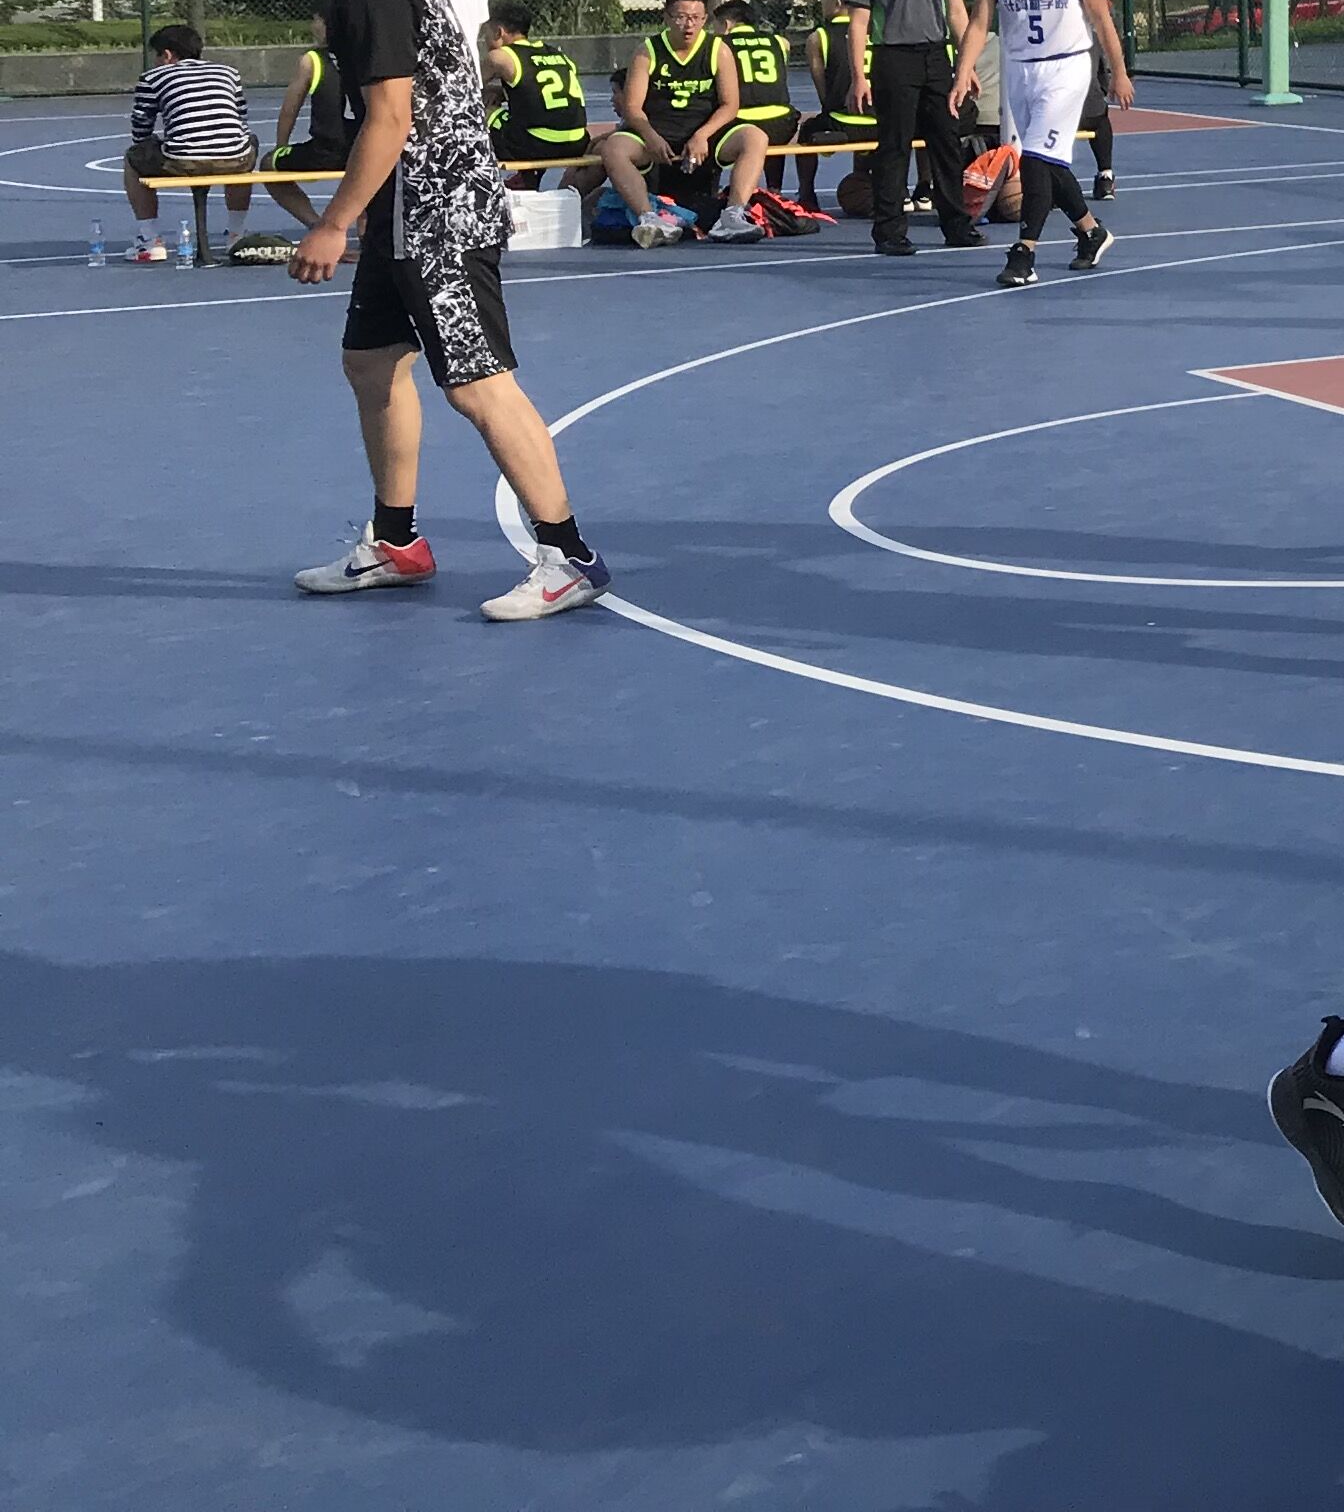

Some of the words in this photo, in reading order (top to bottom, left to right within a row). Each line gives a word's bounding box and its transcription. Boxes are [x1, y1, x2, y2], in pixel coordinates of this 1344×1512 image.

[1027, 15, 1045, 45] 5
[737, 49, 778, 84] 13
[1043, 128, 1060, 150] 5
